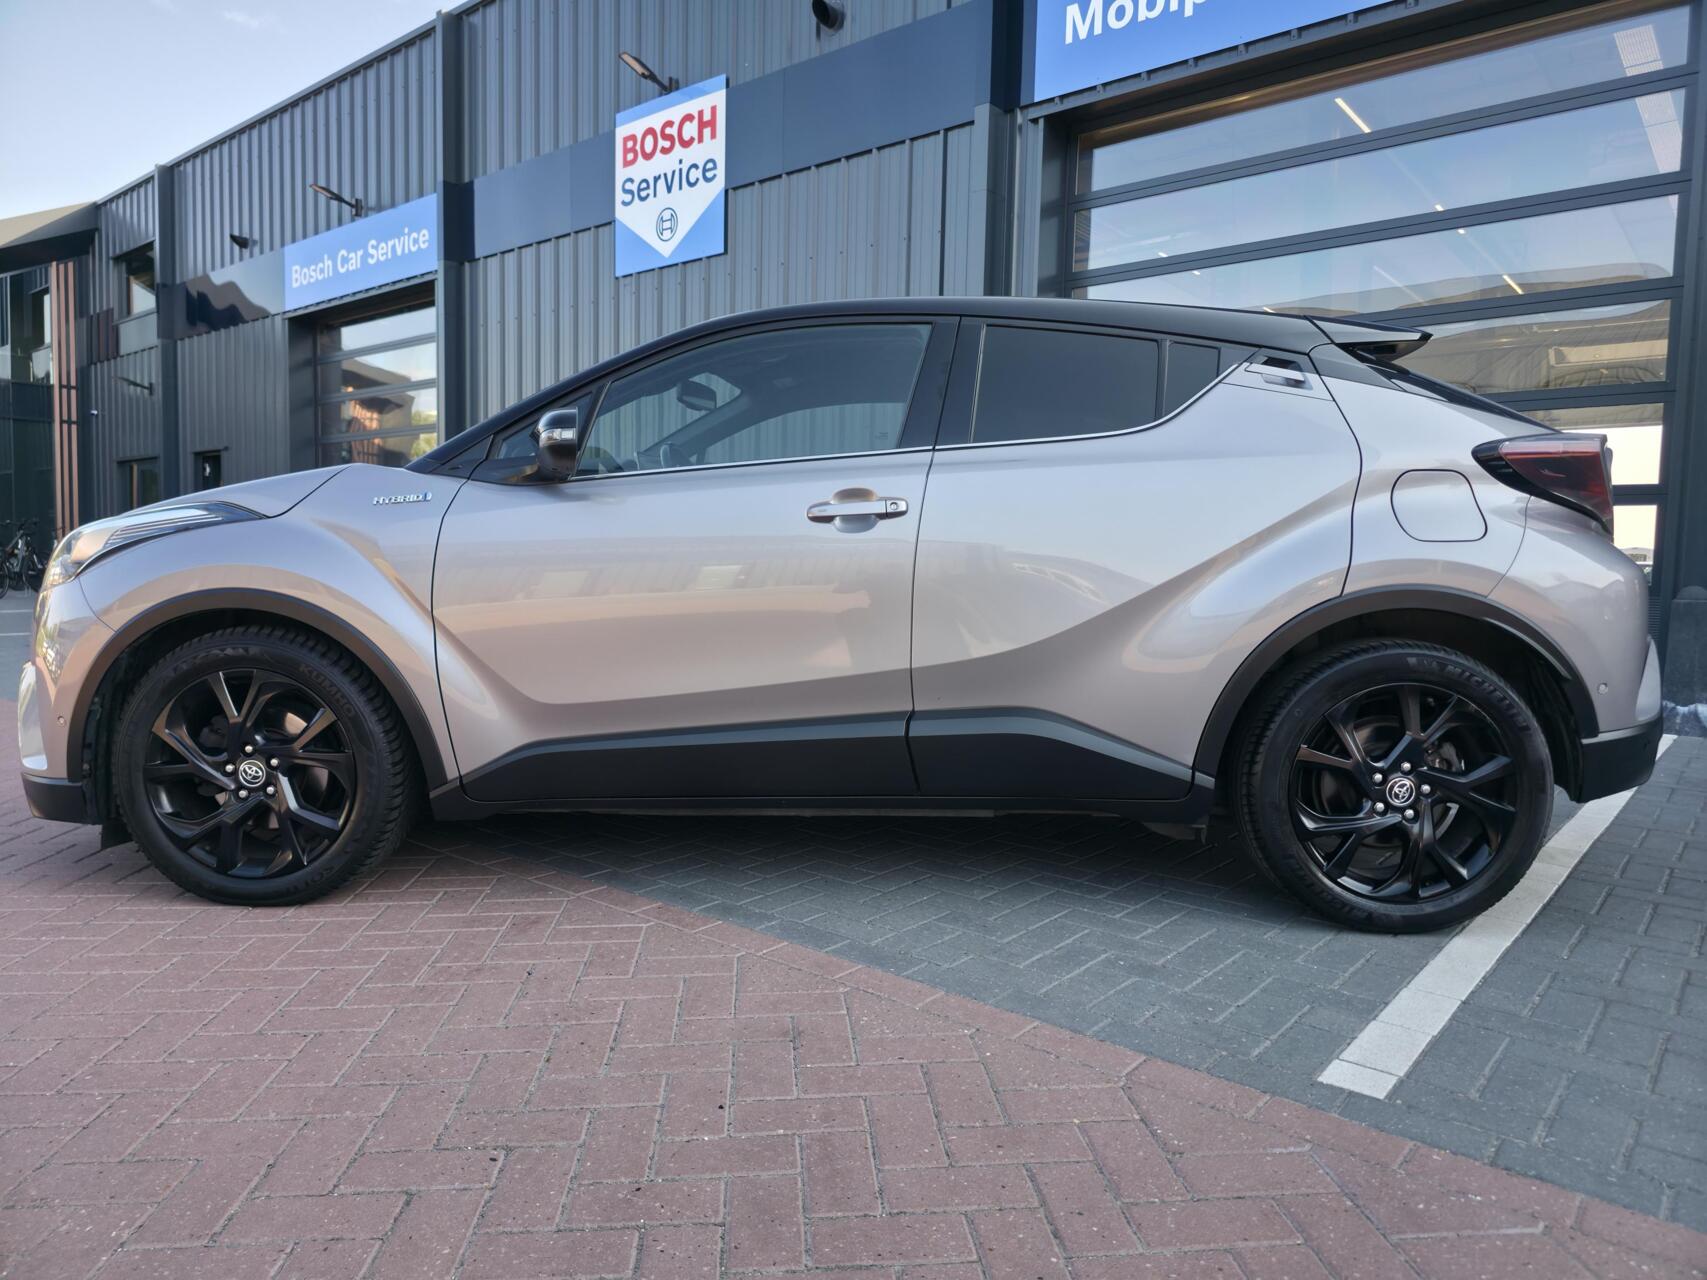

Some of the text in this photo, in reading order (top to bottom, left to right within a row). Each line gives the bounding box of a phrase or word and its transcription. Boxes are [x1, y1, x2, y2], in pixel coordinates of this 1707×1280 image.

[622, 104, 718, 169] BOSCH
[621, 158, 718, 207] Service
[292, 227, 429, 288] Bosch Car Service
[372, 494, 423, 505] HYBRID
